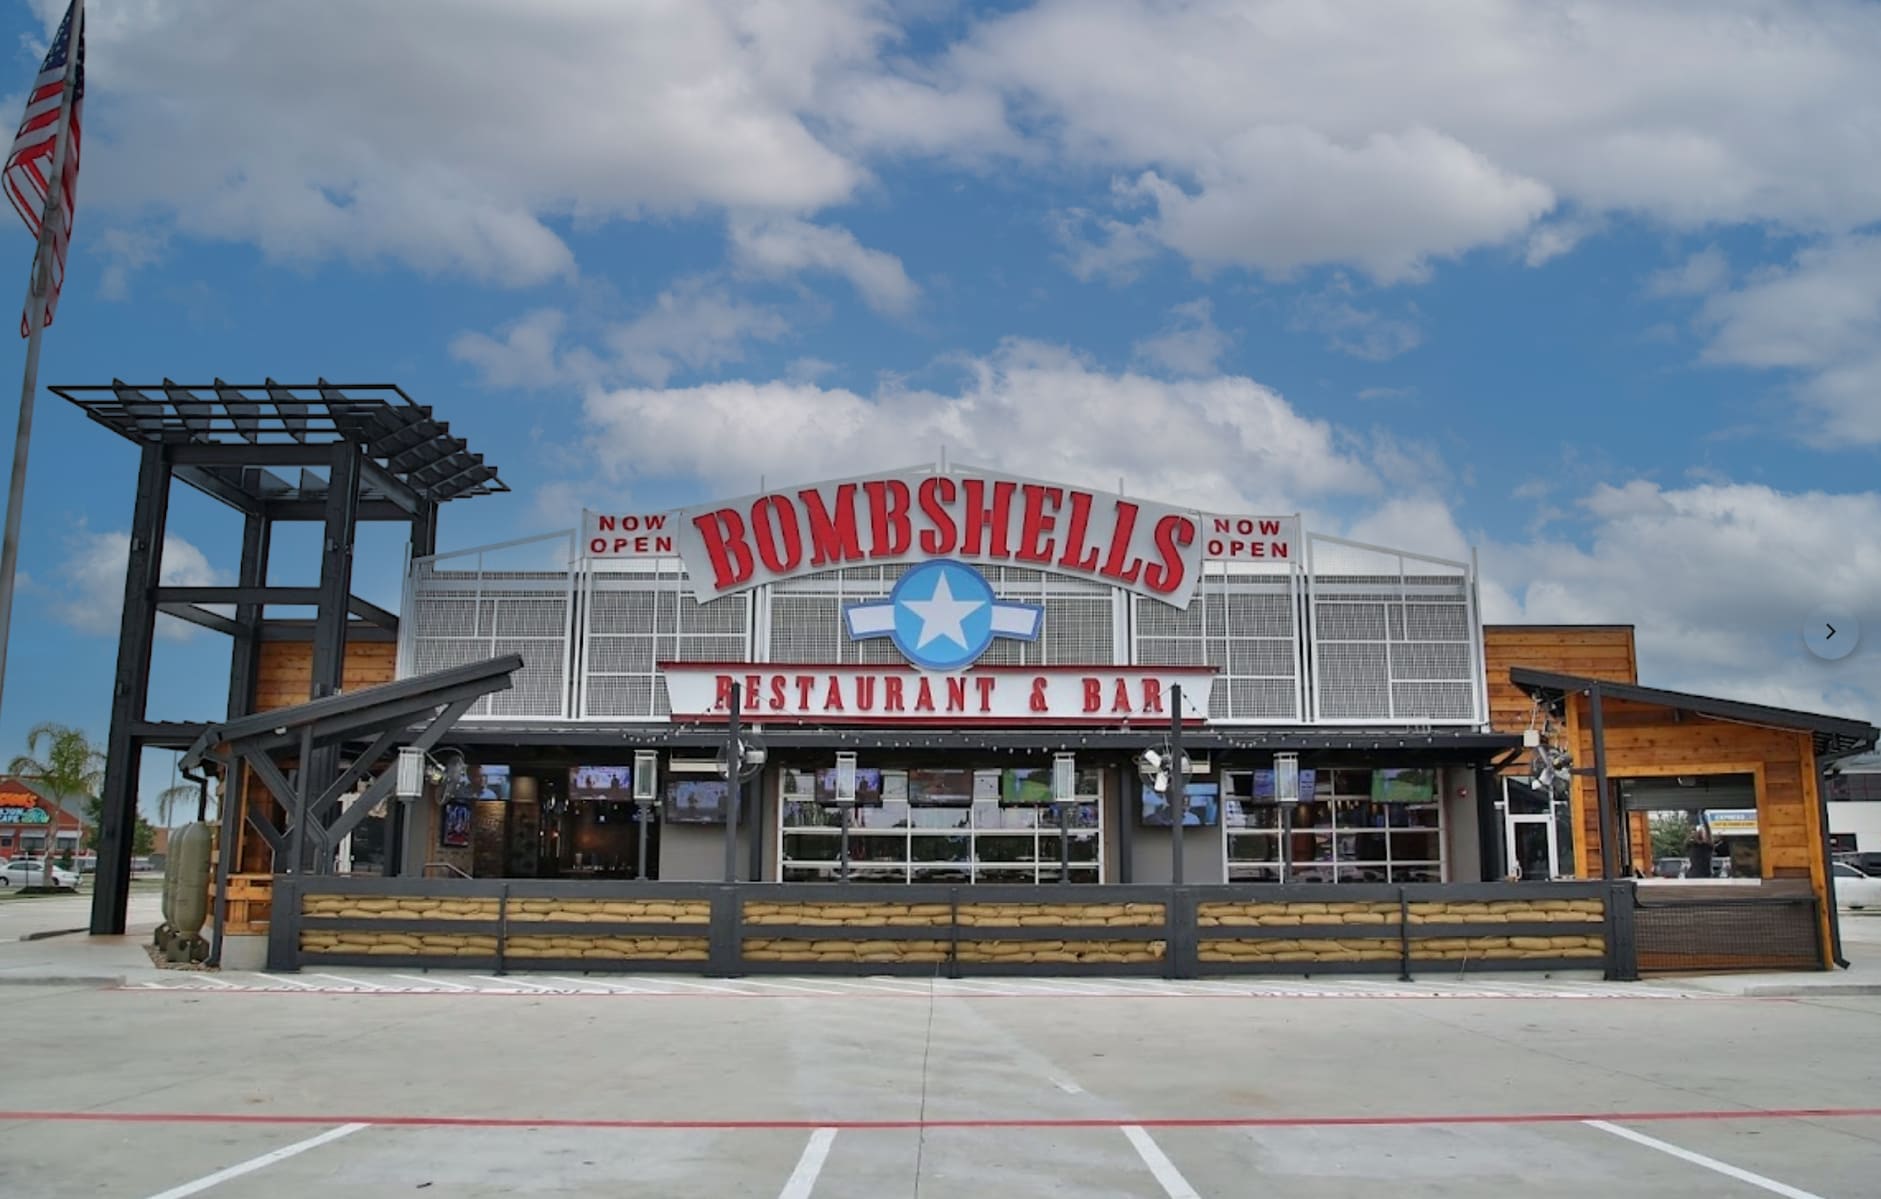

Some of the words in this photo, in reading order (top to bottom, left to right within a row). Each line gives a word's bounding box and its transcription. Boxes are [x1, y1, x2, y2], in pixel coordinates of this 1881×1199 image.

[598, 515, 667, 531] NOW
[1214, 518, 1281, 535] NOW
[693, 476, 1196, 593] BOMBSHELLS
[590, 536, 673, 553] OPEN
[1207, 540, 1288, 557] OPEN
[714, 674, 995, 712] RESTAURANT
[1028, 676, 1049, 712] &
[1082, 677, 1164, 713] BAR
